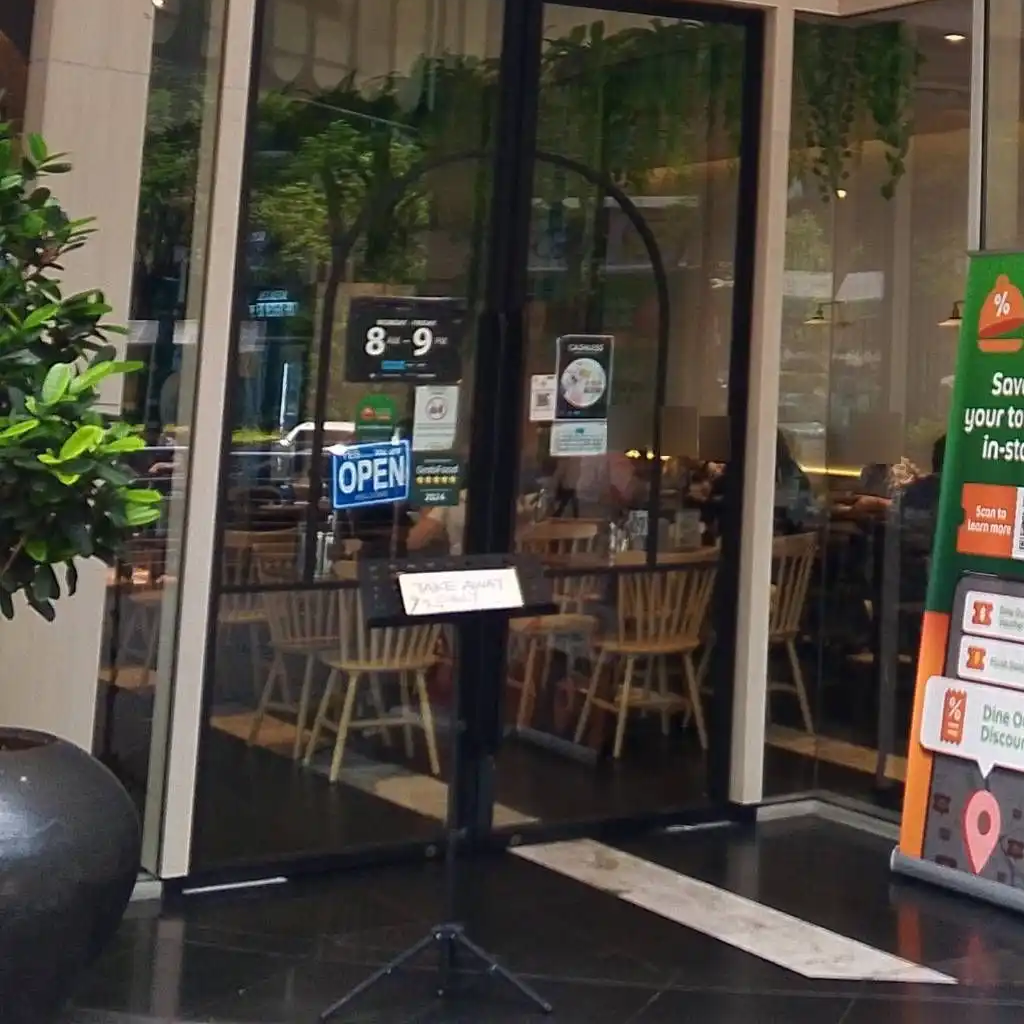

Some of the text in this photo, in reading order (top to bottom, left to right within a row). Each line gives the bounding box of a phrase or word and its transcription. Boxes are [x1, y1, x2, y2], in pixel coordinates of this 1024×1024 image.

[365, 326, 386, 356] 8
[413, 327, 433, 356] 9
[964, 407, 1005, 433] your
[338, 455, 406, 495] OPEN
[975, 505, 1008, 519] Scan to
[990, 521, 1012, 535] more
[983, 704, 1010, 726] Dine
